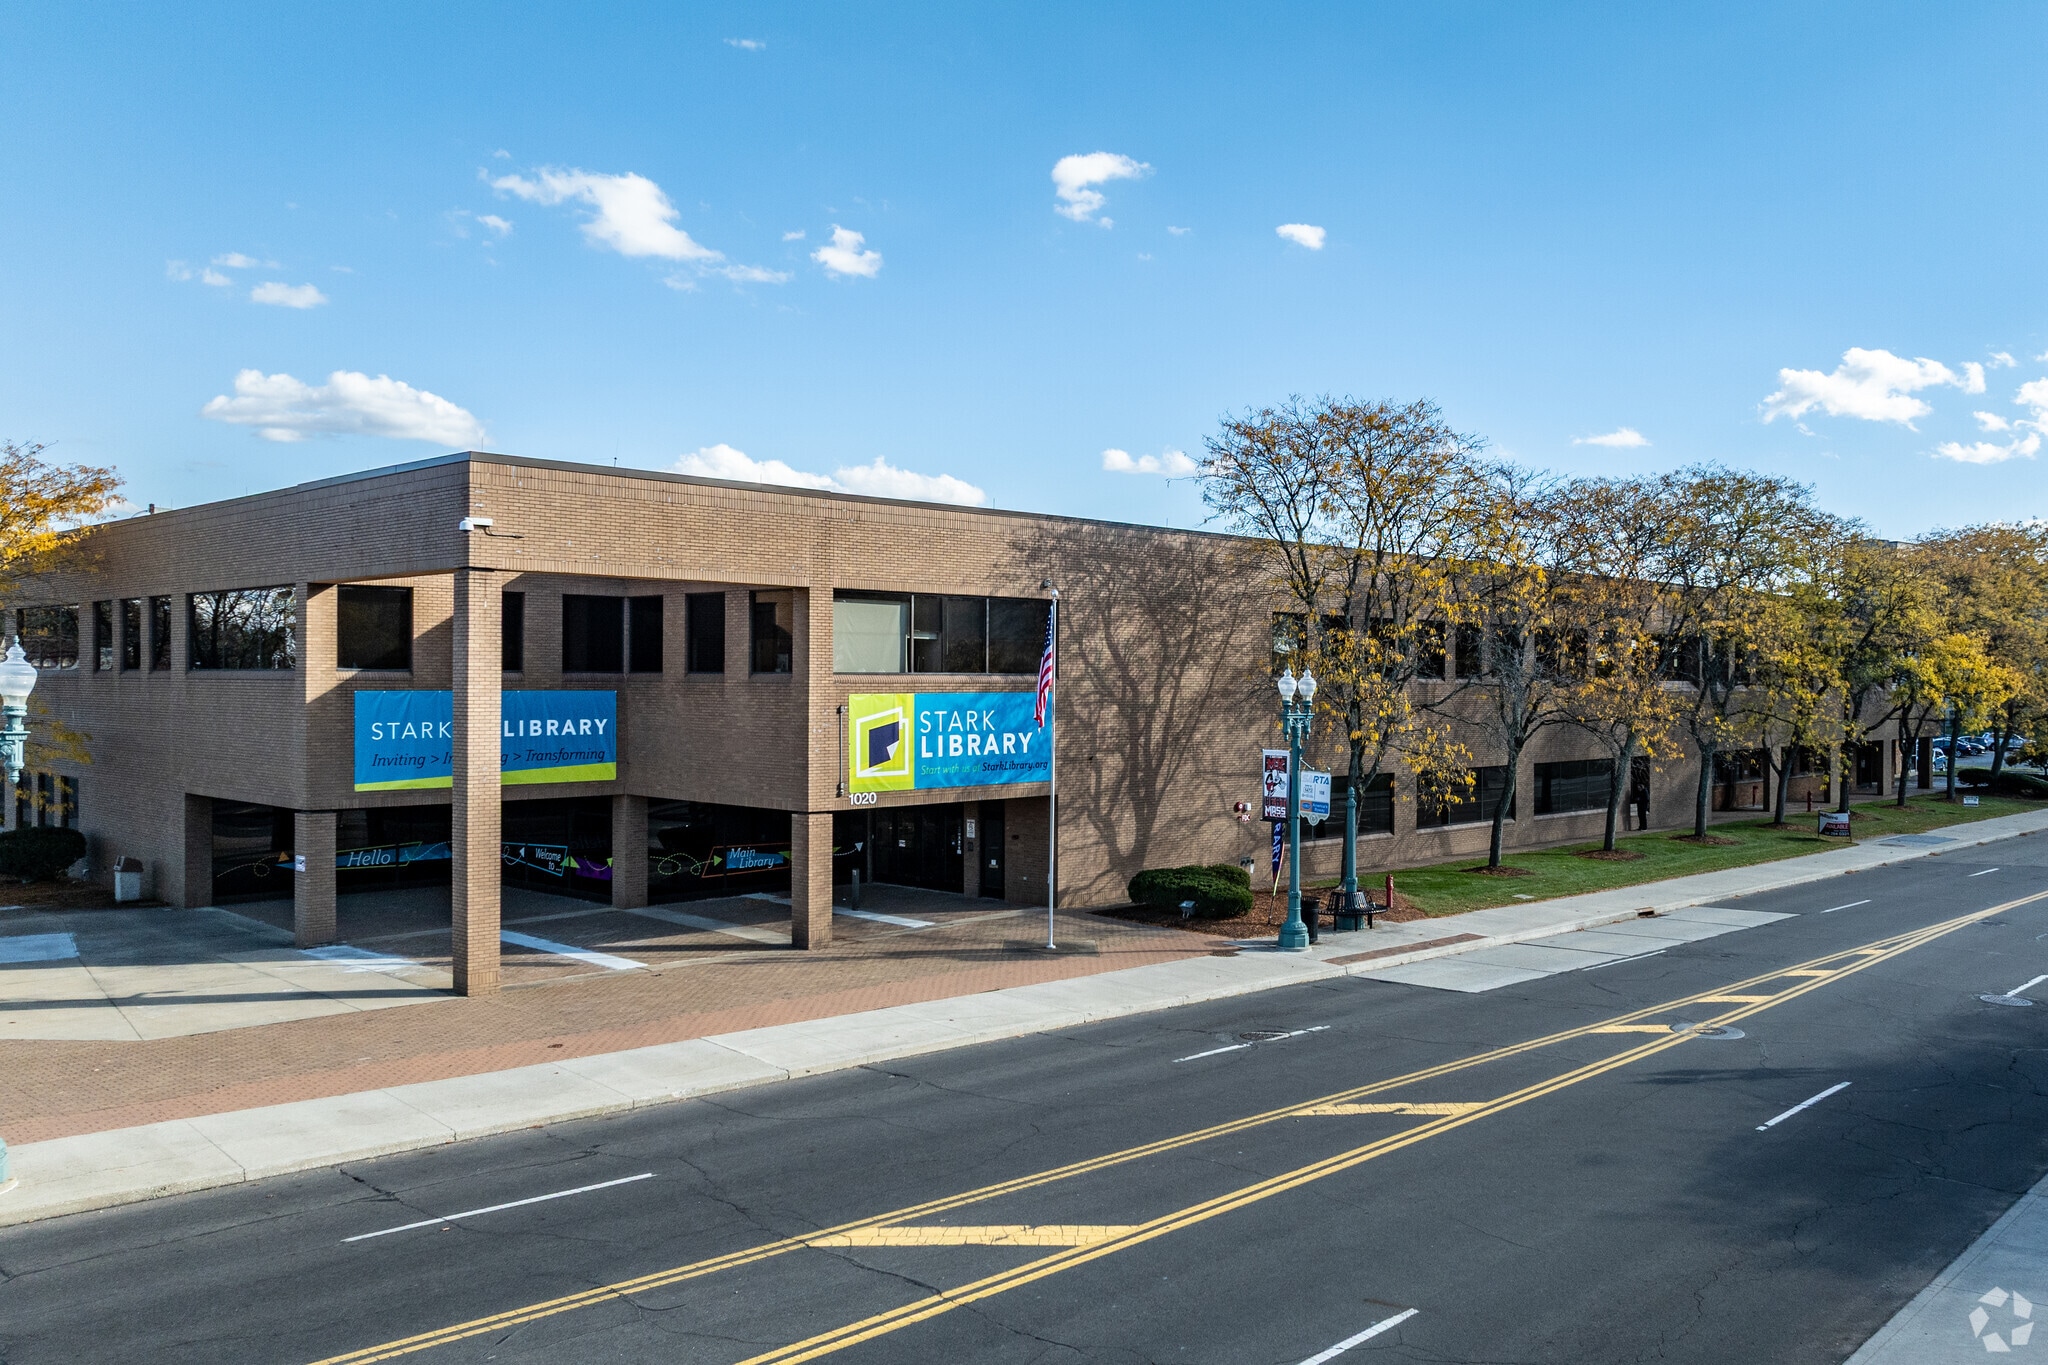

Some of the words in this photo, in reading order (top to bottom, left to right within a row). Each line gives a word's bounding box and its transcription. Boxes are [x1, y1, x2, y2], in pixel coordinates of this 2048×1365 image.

[371, 721, 453, 741] STARK
[503, 718, 608, 737] LIBRARY
[920, 710, 995, 733] STARK
[921, 732, 1032, 758] LIBRARY
[371, 753, 426, 769] Inviting
[525, 748, 605, 764] Transforming
[921, 764, 940, 776] Start
[942, 763, 959, 774] with
[962, 765, 970, 773] us
[982, 761, 1048, 772] StarkLibrary.org
[849, 791, 877, 805] 1020
[1272, 822, 1281, 862] RARY
[346, 849, 391, 867] Hello
[535, 847, 562, 862] Welcome
[729, 847, 756, 860] Main
[548, 861, 555, 870] to
[739, 856, 775, 869] Library
